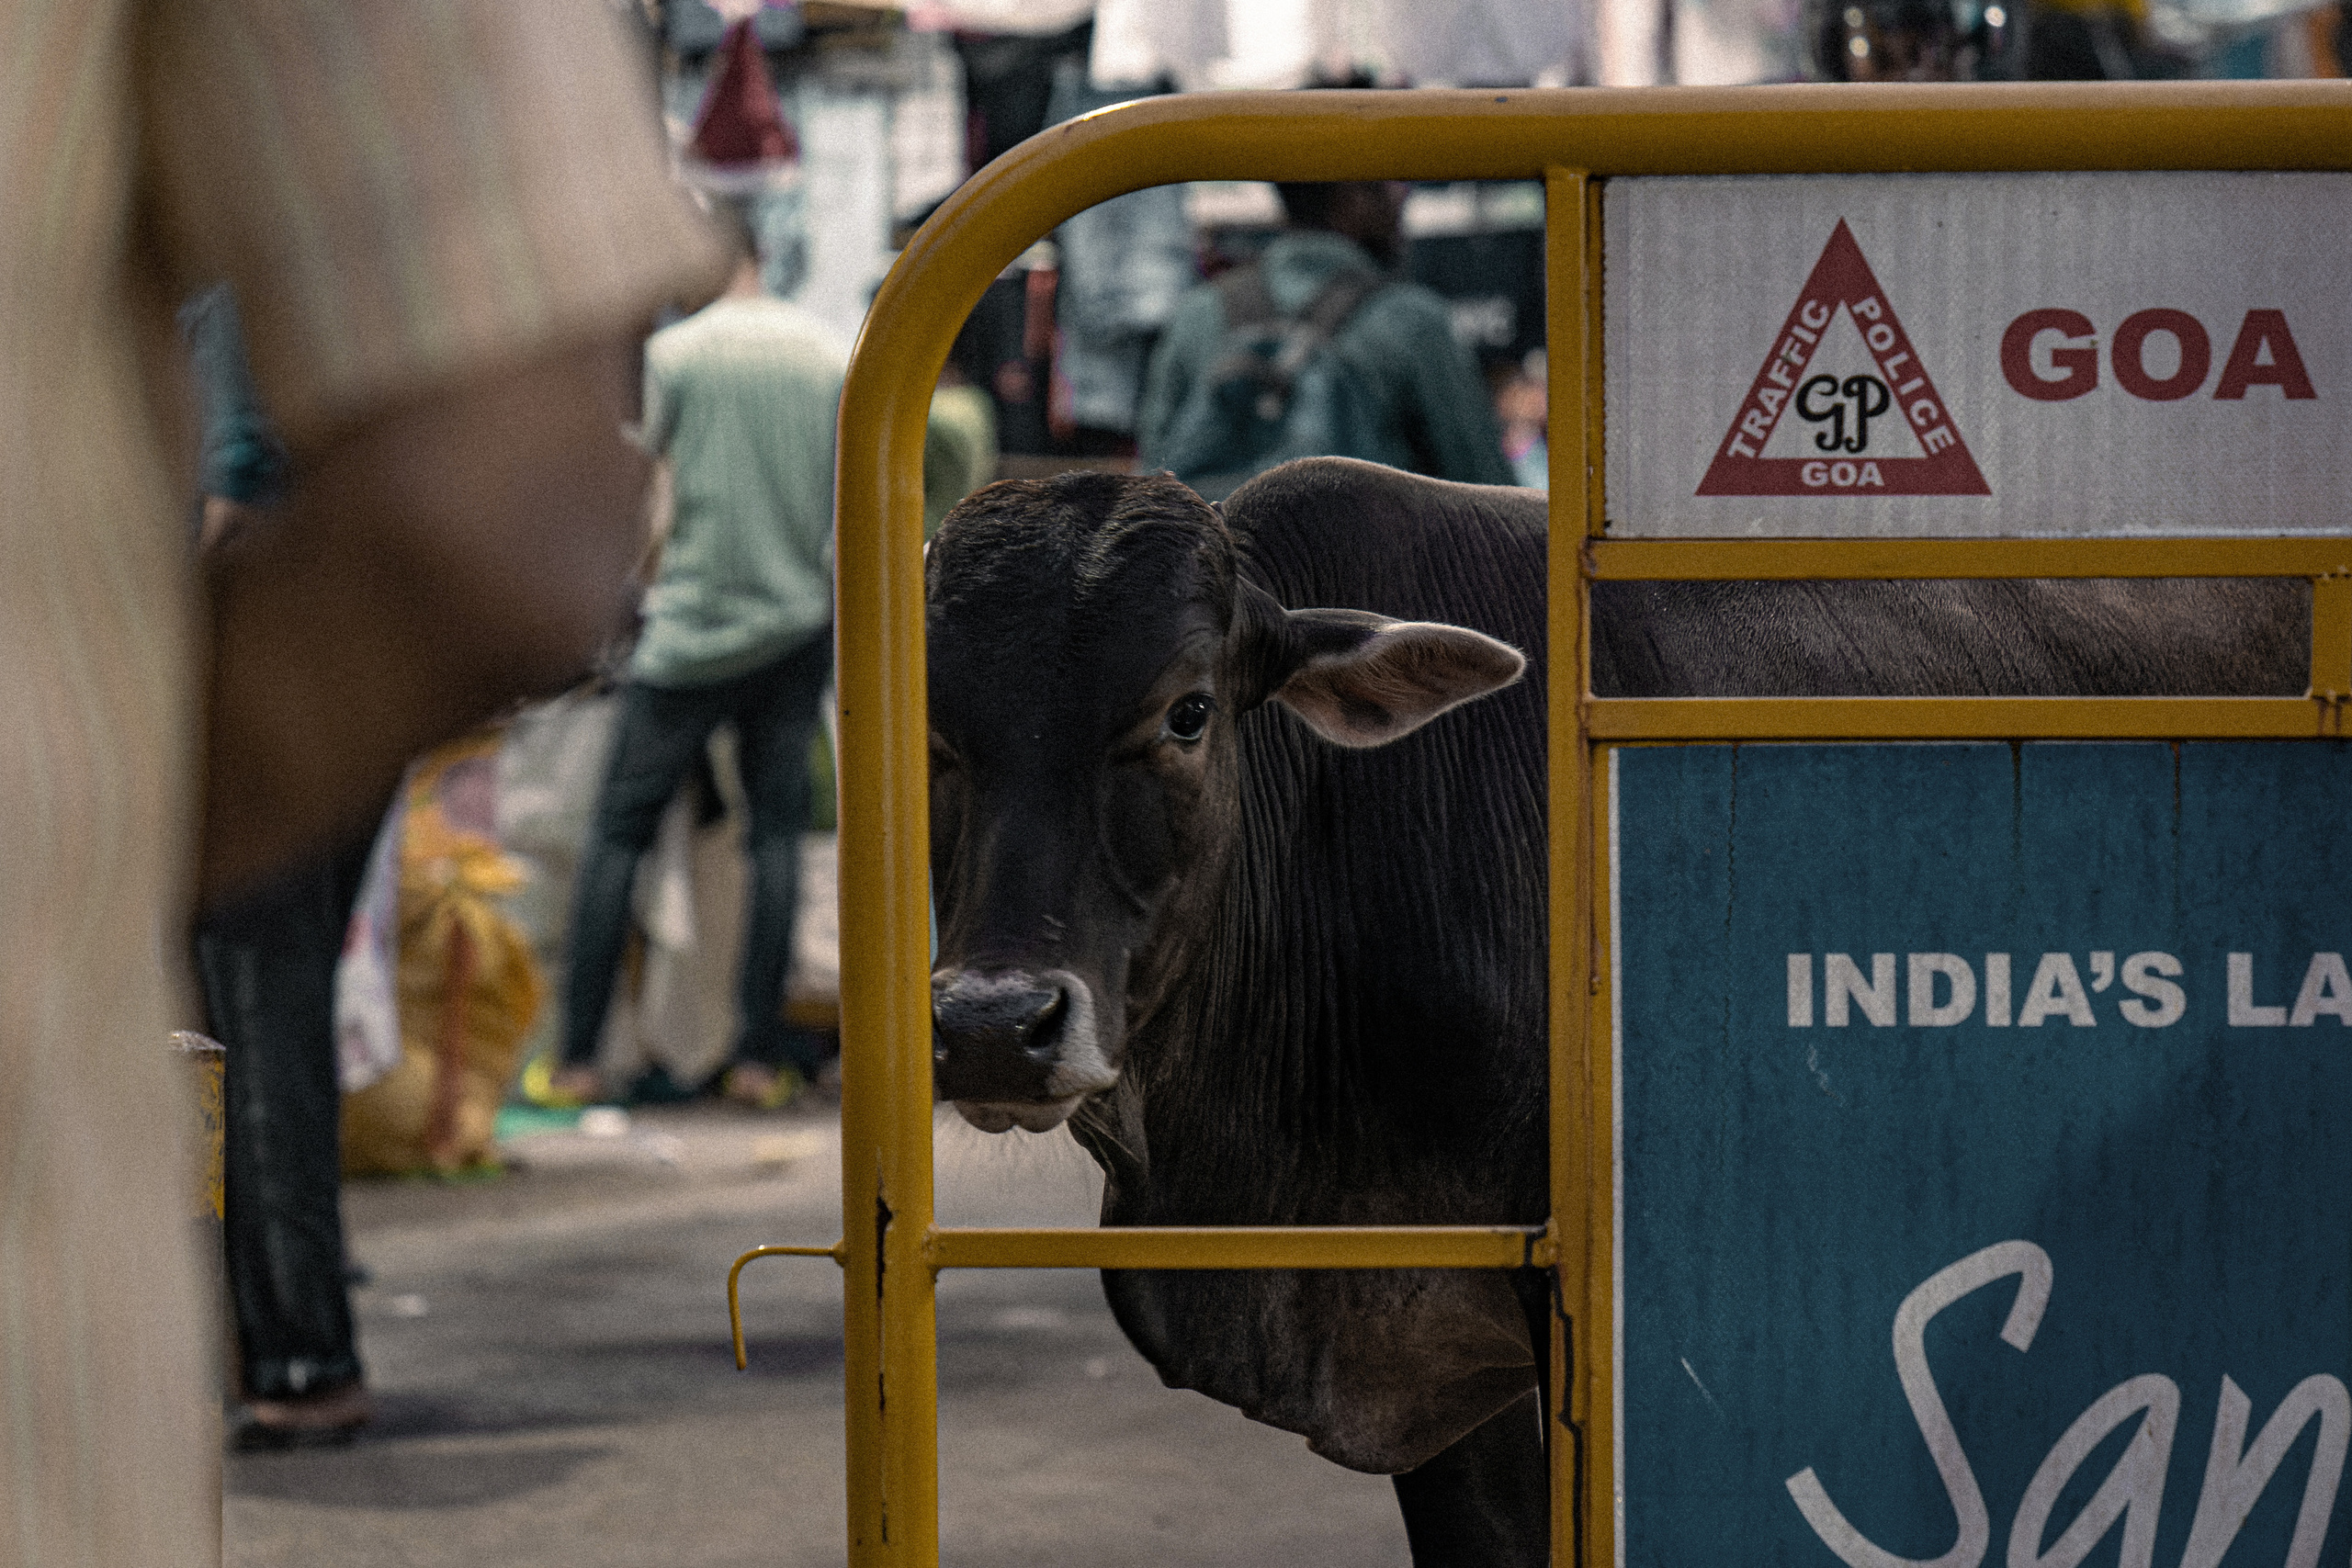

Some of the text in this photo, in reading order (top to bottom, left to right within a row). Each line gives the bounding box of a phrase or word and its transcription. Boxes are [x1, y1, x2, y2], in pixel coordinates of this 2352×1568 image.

[1727, 296, 1955, 460] TRAFFIC POLICE
[2000, 308, 2318, 402] GOA
[1801, 461, 1885, 488] GOA
[1786, 951, 2352, 1028] INDIA'S LA
